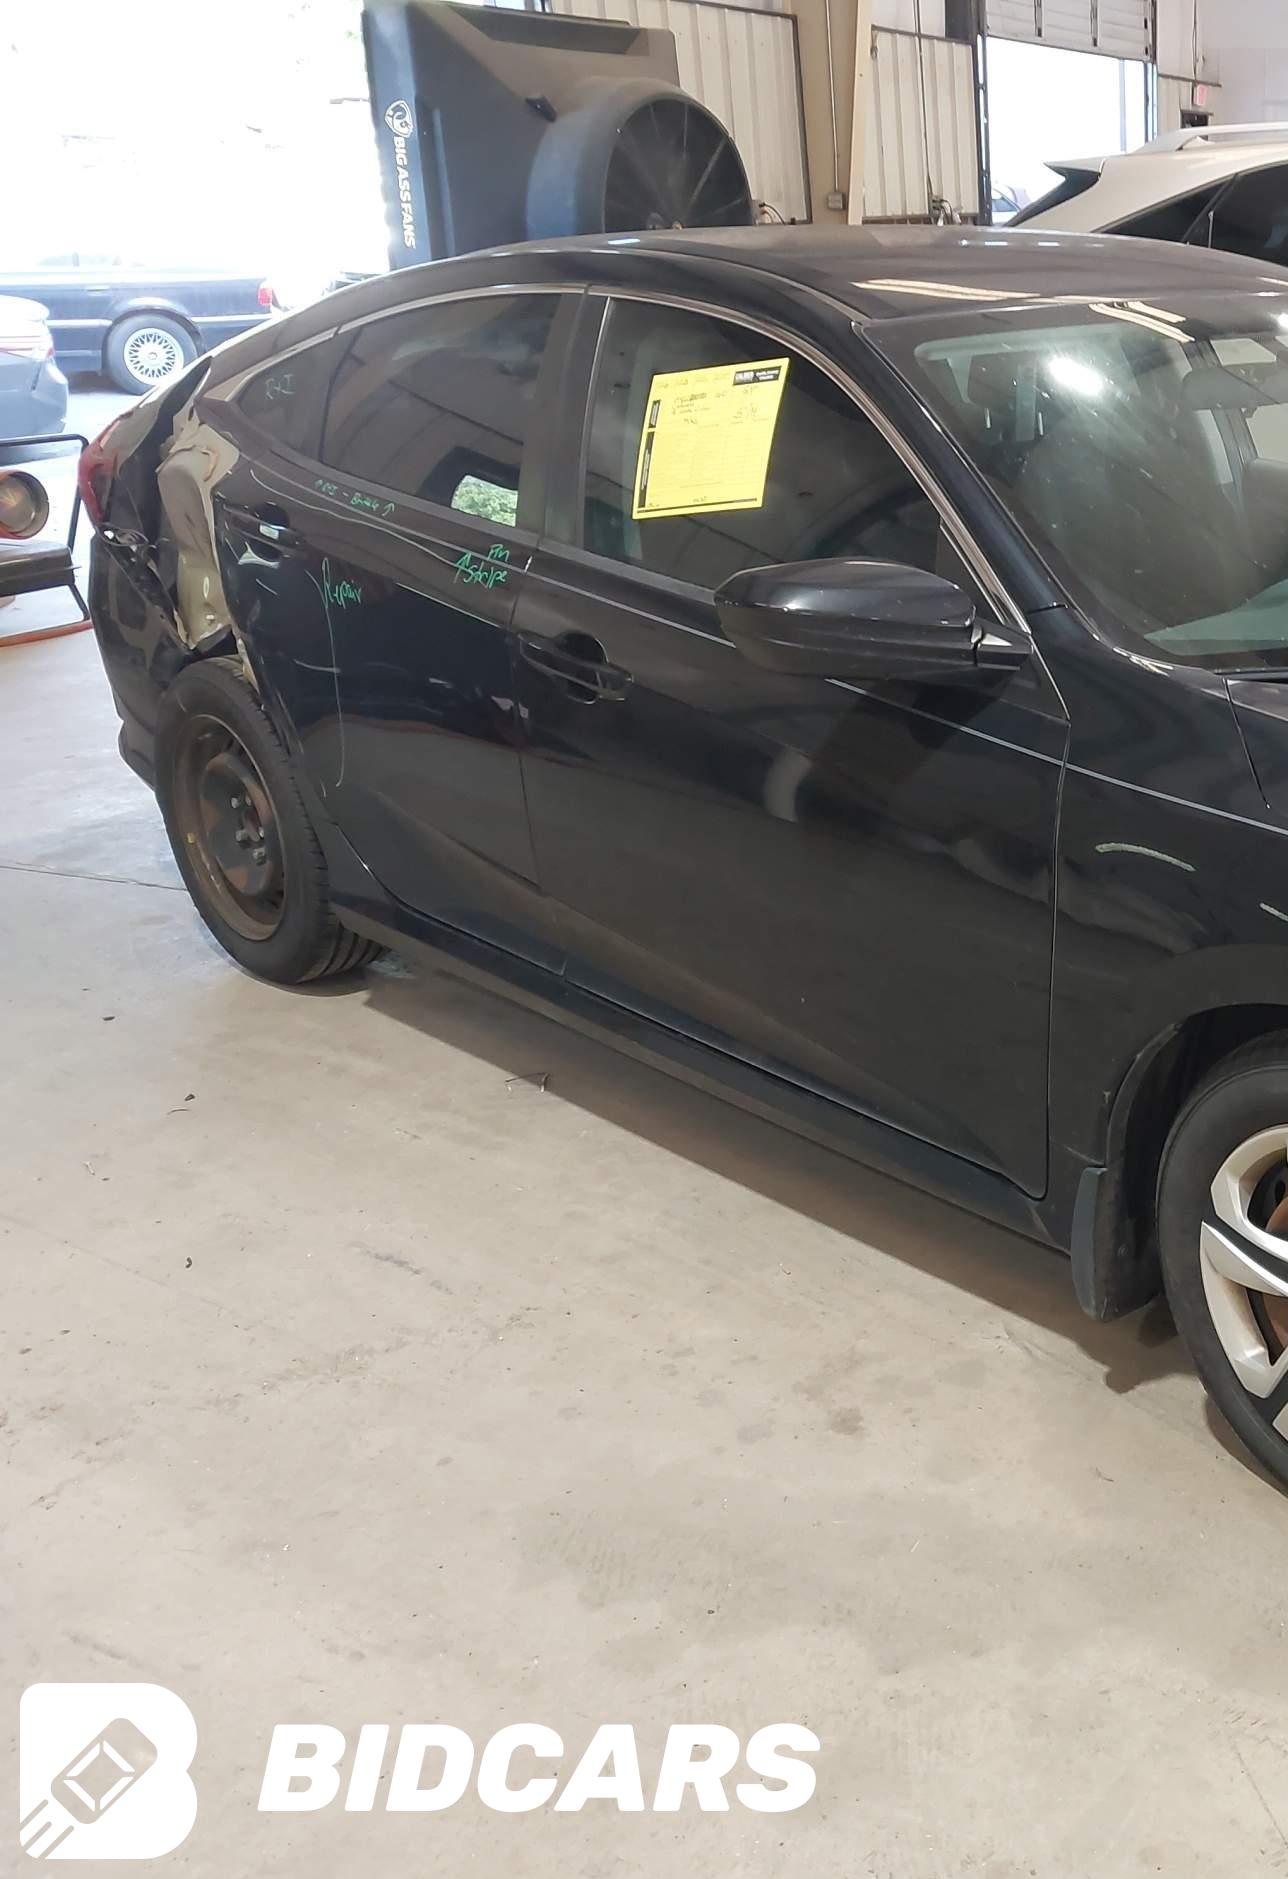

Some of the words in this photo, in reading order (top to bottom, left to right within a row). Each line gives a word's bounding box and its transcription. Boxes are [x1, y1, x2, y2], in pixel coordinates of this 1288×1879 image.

[394, 136, 408, 167] BIG
[397, 166, 412, 203] ASS
[401, 201, 417, 249] FANS
